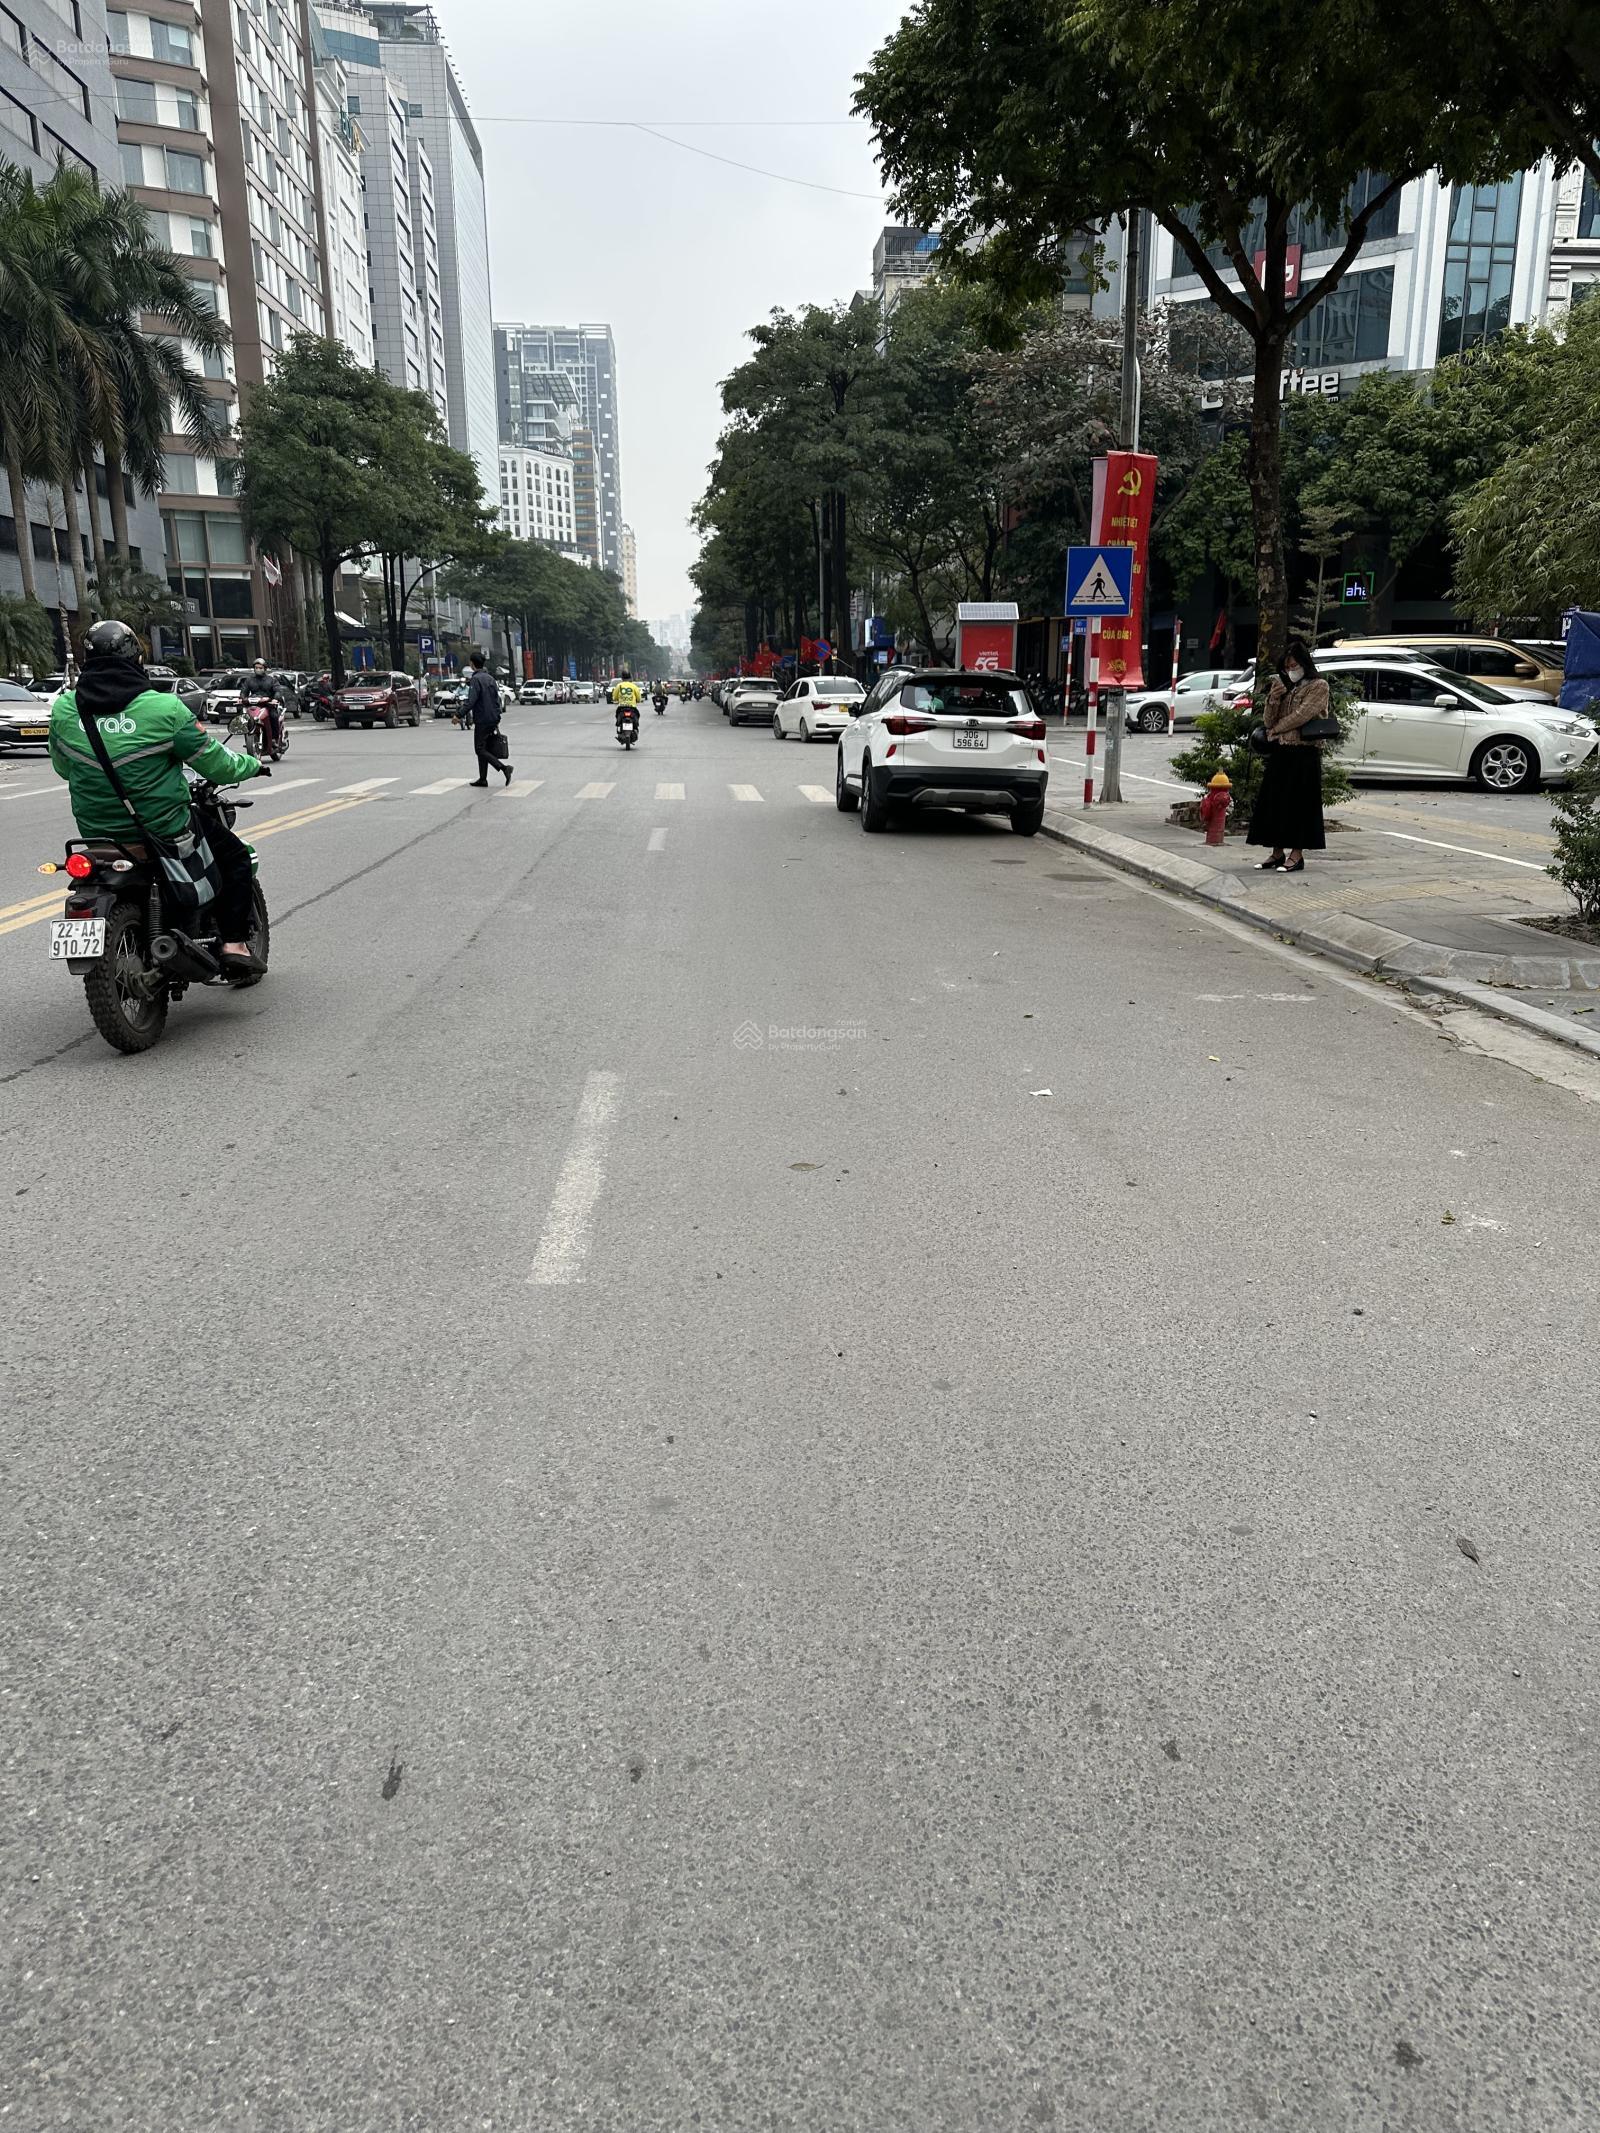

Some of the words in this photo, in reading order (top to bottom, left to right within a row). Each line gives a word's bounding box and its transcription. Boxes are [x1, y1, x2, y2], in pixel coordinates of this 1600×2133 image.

[421, 638, 432, 649] P
[975, 657, 999, 672] 5G
[619, 685, 633, 696] be
[964, 731, 979, 739] 30G
[58, 921, 96, 939] 22-AA
[53, 939, 100, 956] 910.72
